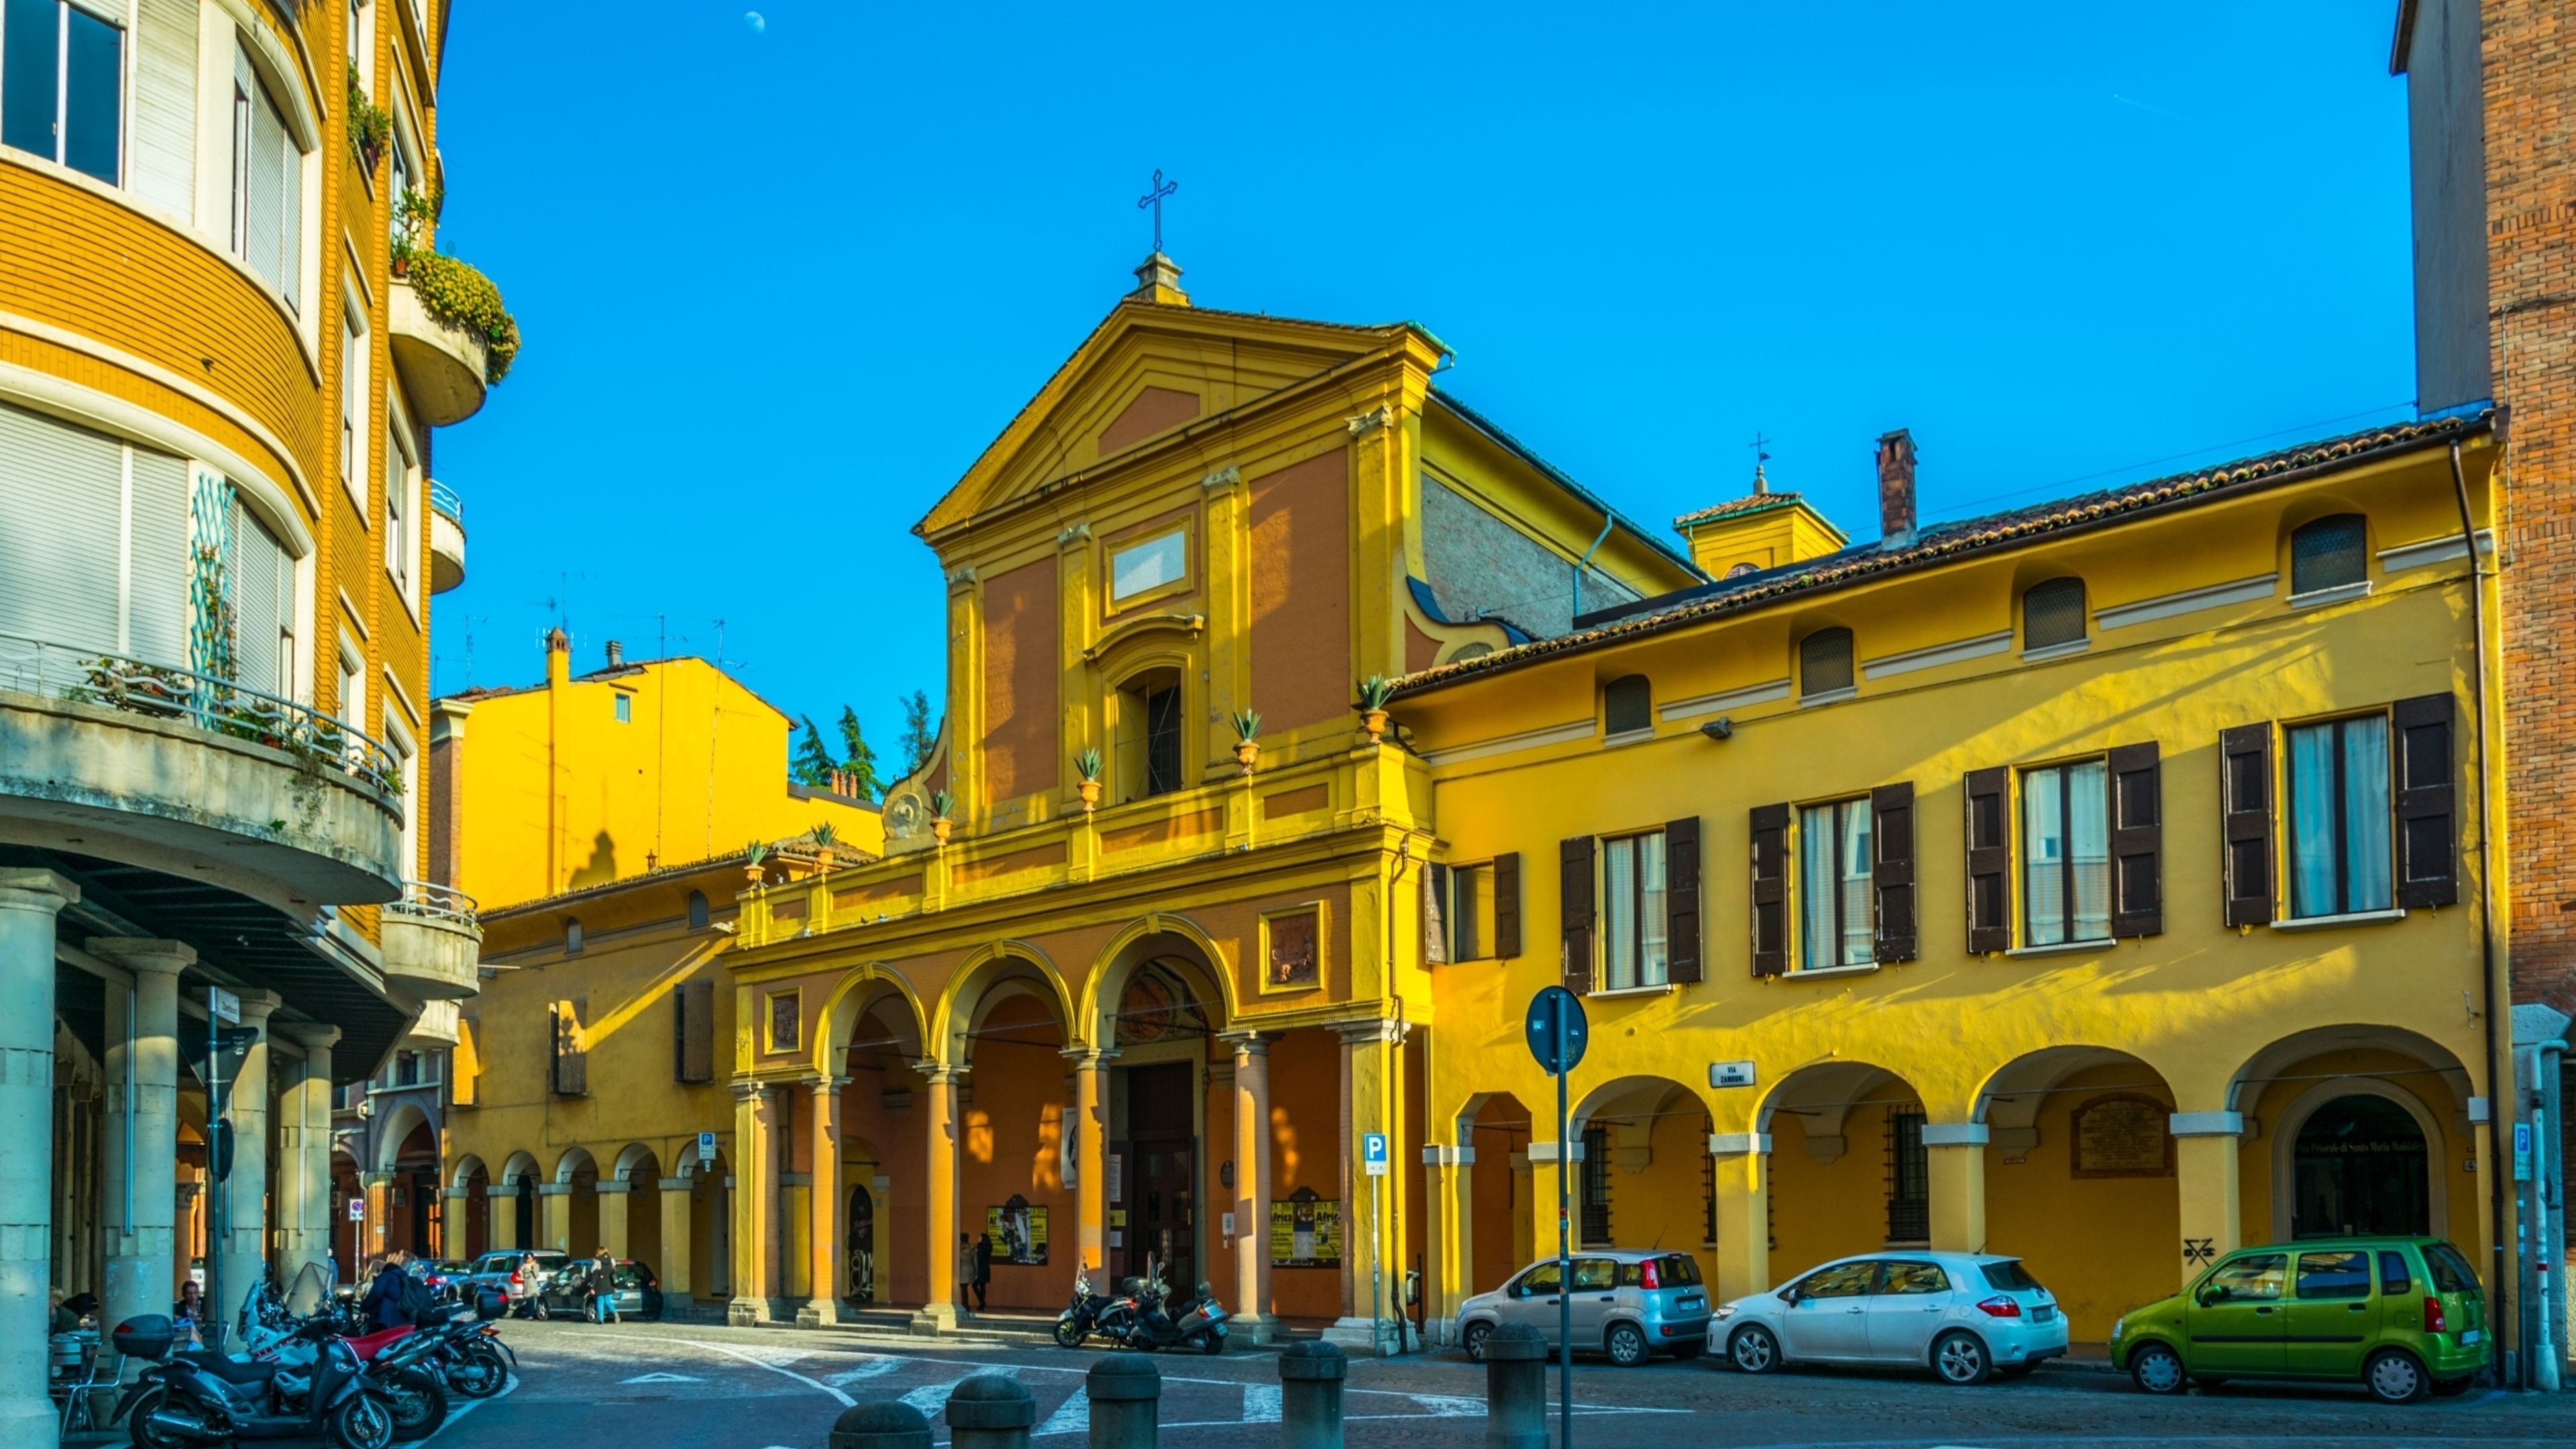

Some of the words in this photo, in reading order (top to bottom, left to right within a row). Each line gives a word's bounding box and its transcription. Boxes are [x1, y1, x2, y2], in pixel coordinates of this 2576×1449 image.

[1721, 1075, 1744, 1083] ZAMBONI
[704, 1135, 710, 1144] P
[2520, 1132, 2526, 1148] P
[1369, 1137, 1382, 1159] P
[1316, 1212, 1340, 1222] Afric
